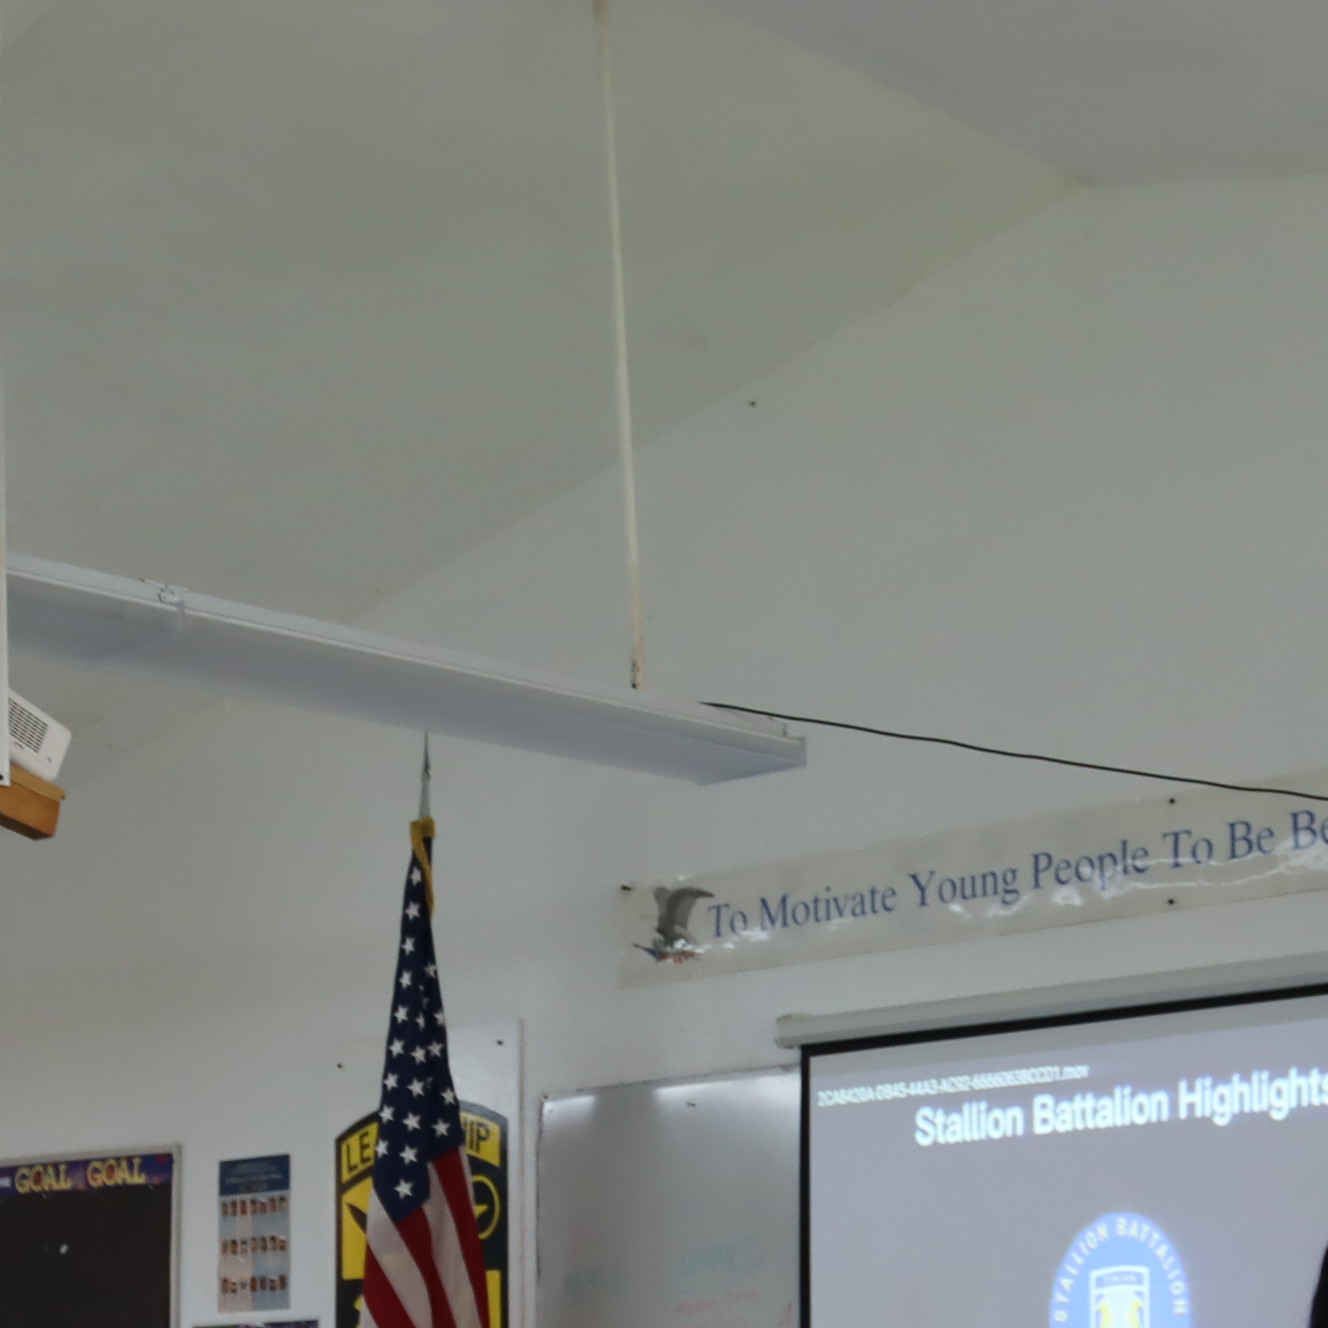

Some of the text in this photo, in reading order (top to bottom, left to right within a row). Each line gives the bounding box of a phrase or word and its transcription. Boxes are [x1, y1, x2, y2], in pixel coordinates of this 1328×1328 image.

[708, 902, 748, 938] To
[759, 884, 897, 932] Motivate
[908, 866, 1020, 907] Young
[1030, 838, 1150, 893] People
[1162, 830, 1213, 869] To
[1228, 817, 1276, 859] Be
[914, 1100, 1024, 1146] Stallion
[1032, 1085, 1169, 1135] Battalion
[14, 1163, 72, 1194] GOAL
[85, 1157, 147, 1189] GOAL
[1053, 1217, 1188, 1323] STALLION BATTALION
